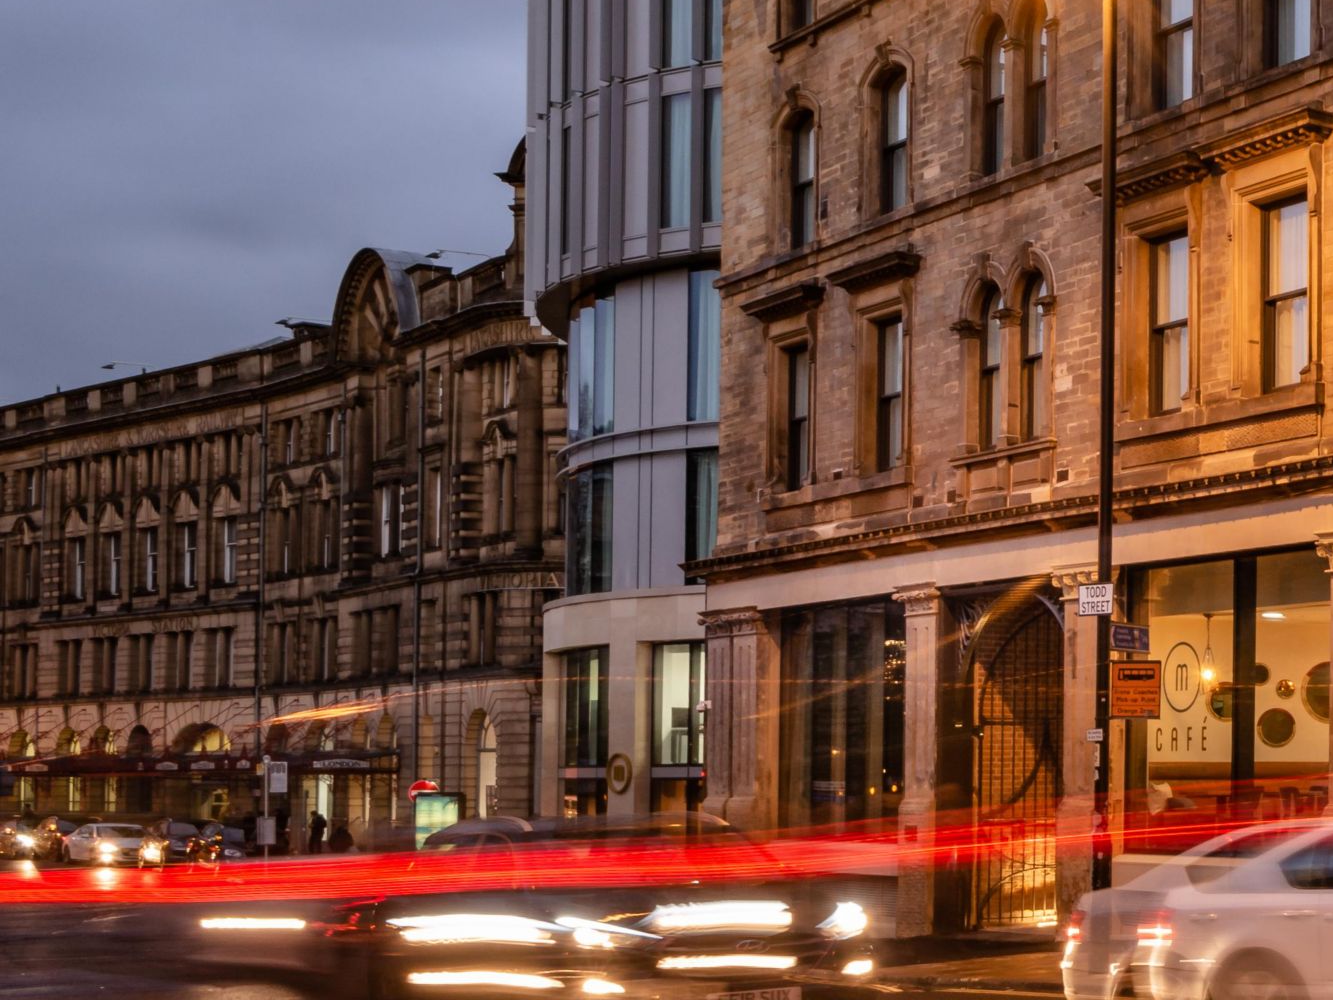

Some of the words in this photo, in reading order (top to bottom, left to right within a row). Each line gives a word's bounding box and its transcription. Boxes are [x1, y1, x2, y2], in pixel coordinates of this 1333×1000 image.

[1085, 586, 1107, 599] TODD
[1081, 600, 1111, 613] STREET
[1175, 663, 1189, 692] m
[1155, 716, 1208, 752] CAFÉ
